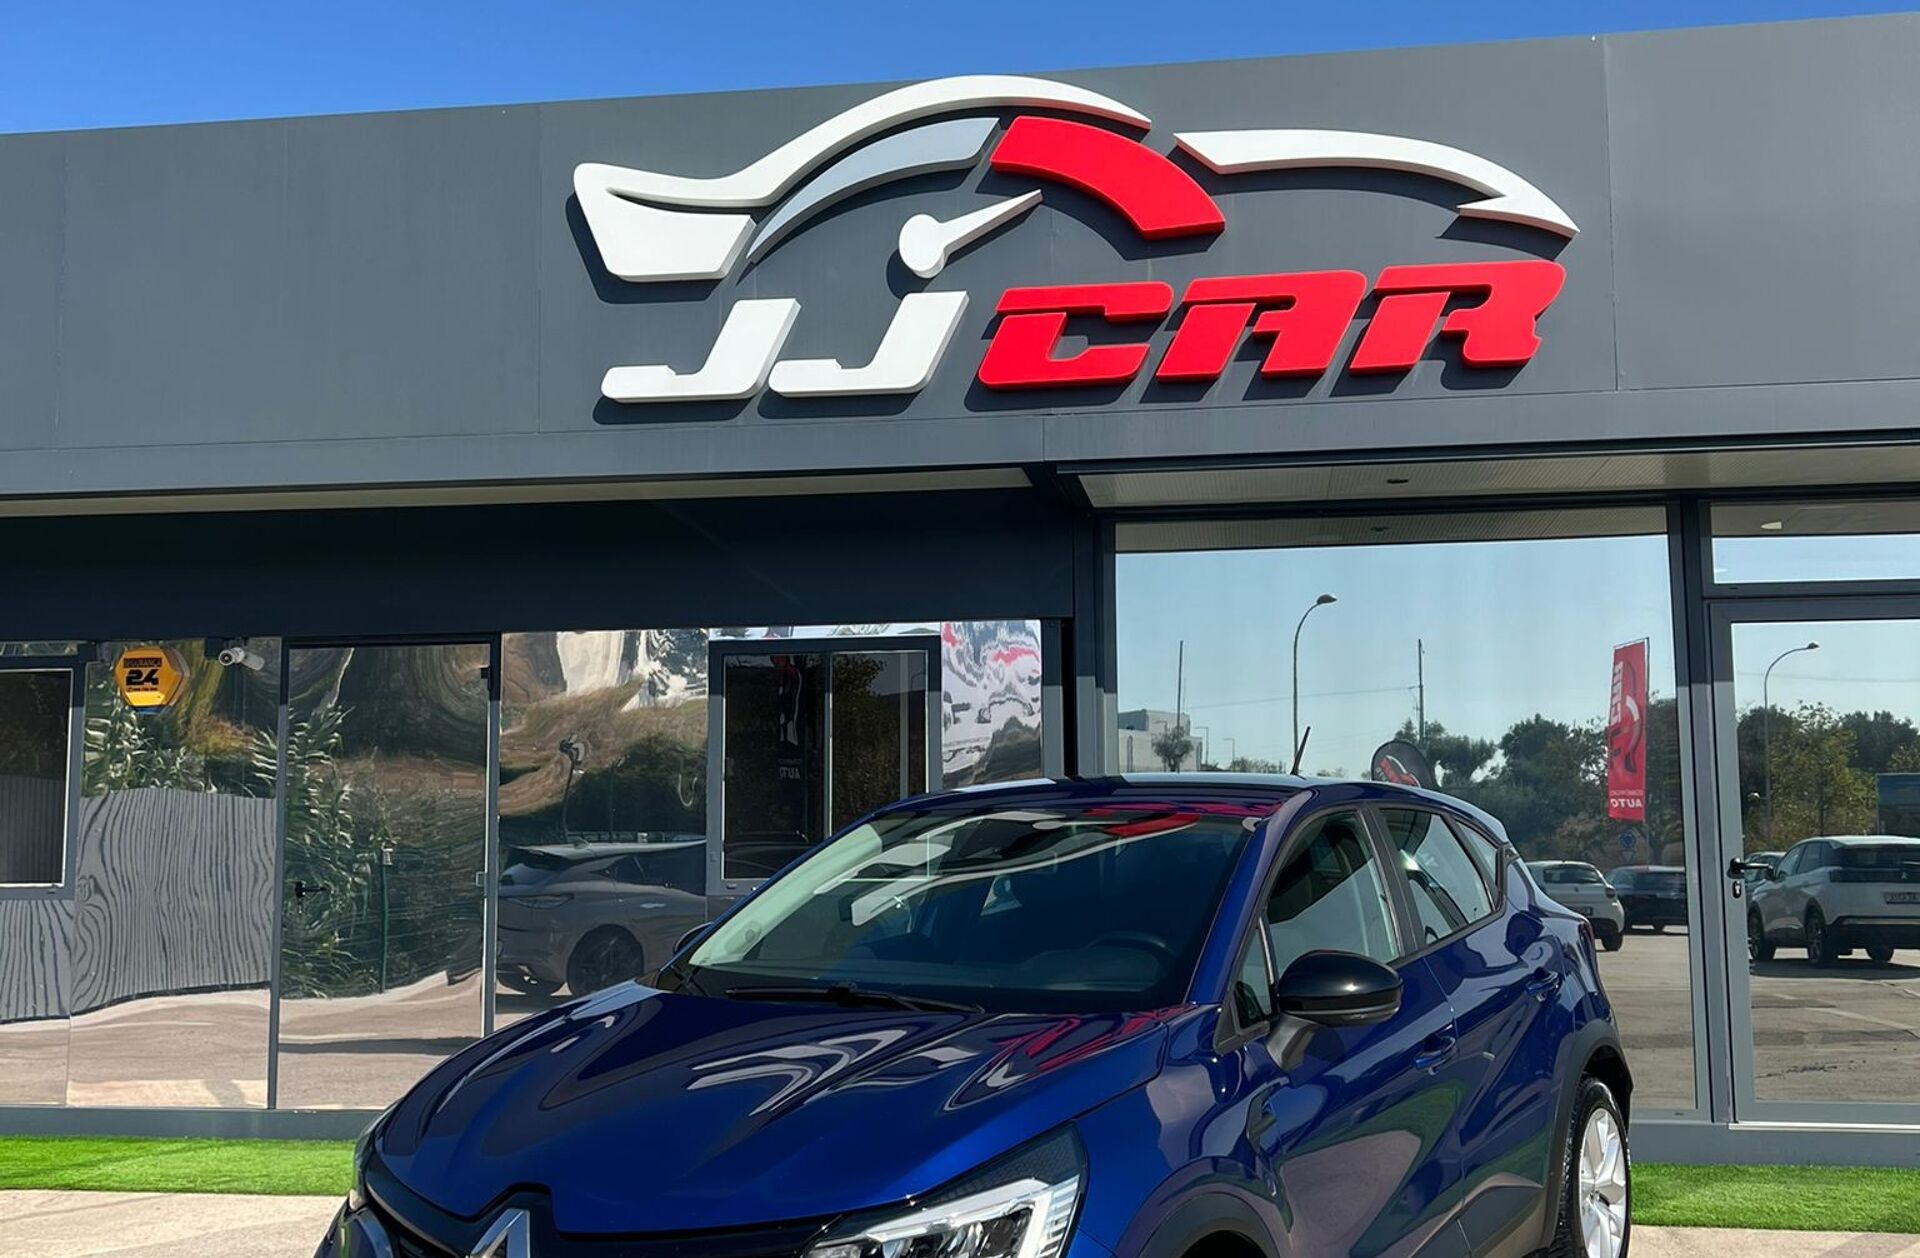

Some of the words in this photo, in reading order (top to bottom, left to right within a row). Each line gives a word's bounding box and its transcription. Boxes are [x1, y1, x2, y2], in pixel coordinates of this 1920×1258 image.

[601, 290, 969, 403] JJ
[978, 260, 1566, 389] CAR
[126, 669, 160, 686] 24
